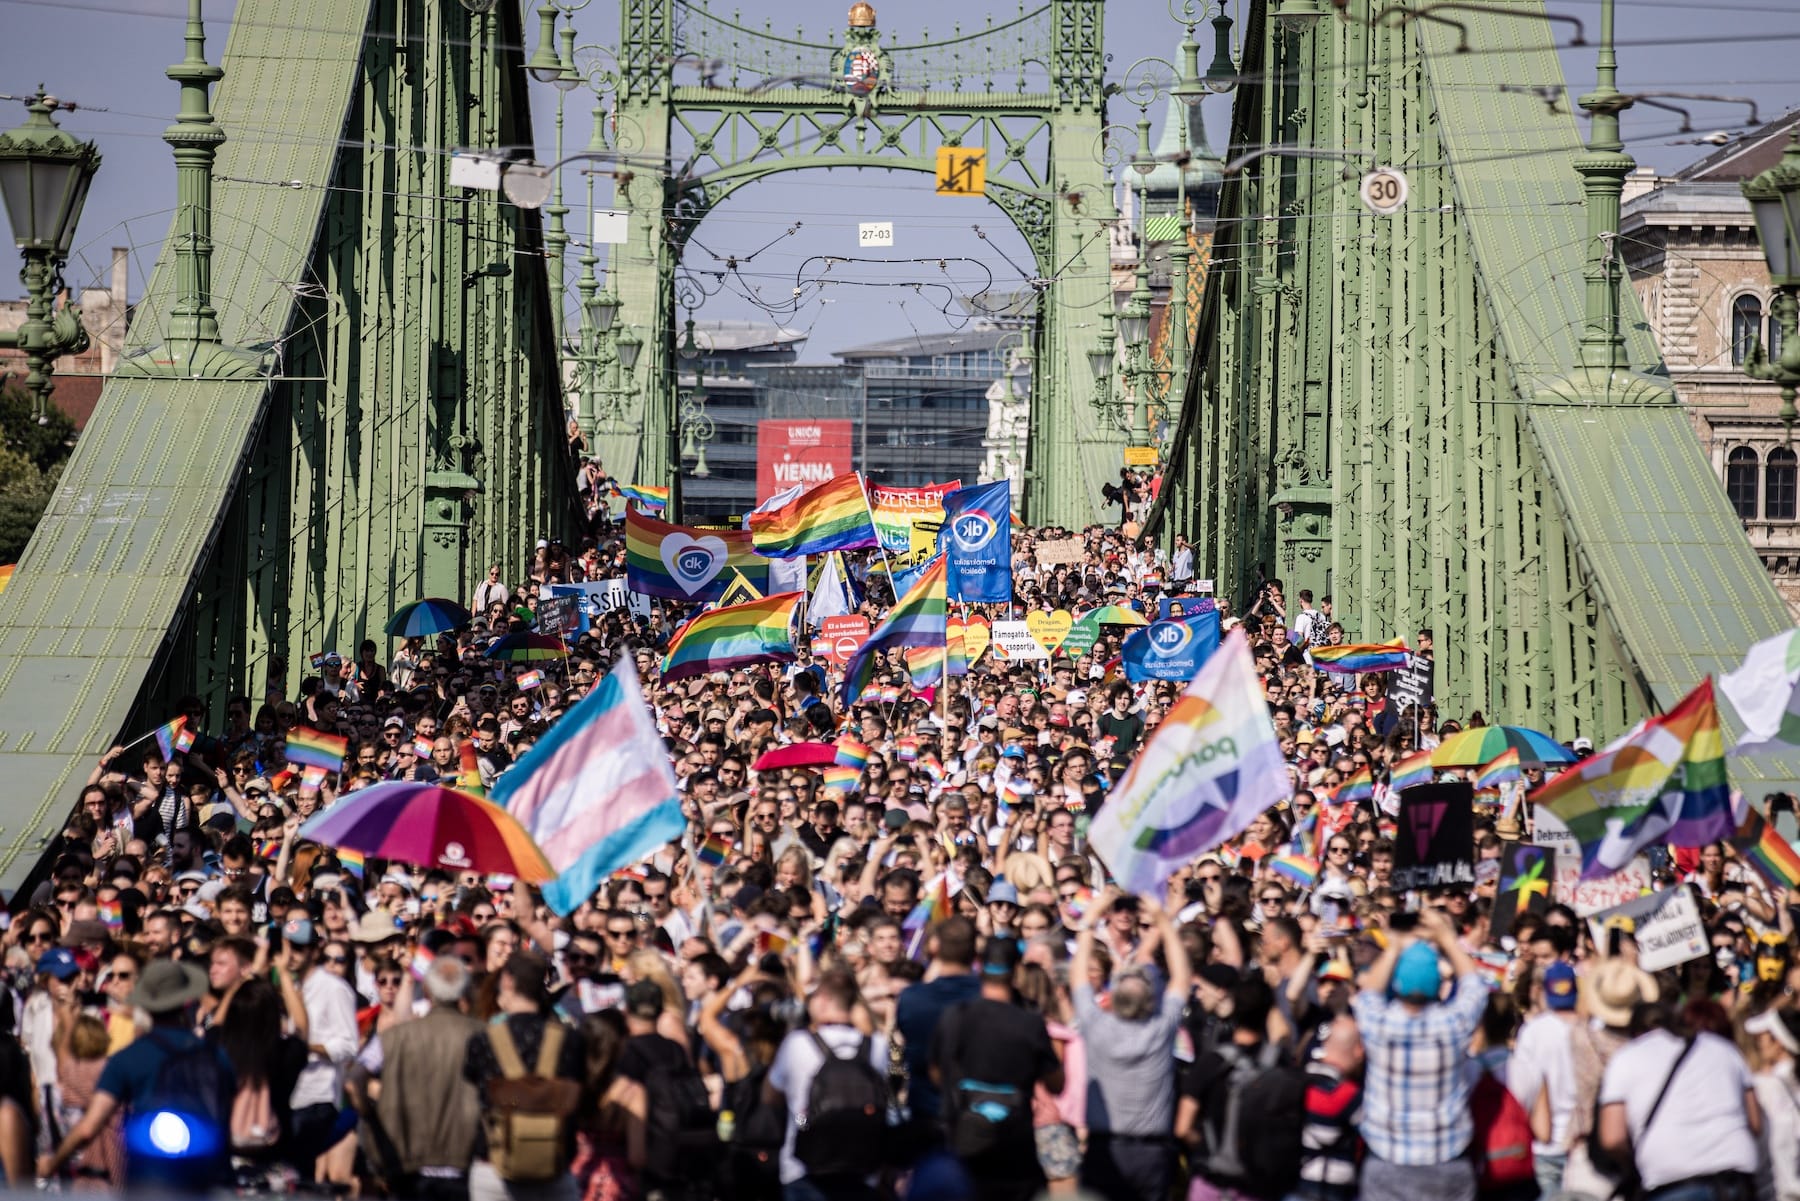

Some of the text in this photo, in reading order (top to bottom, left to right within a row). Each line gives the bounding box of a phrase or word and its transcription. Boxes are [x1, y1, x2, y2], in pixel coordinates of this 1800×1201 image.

[1371, 180, 1398, 200] 30
[862, 229, 891, 240] 27-03
[684, 556, 704, 570] dk
[585, 588, 641, 611] SSÜK!
